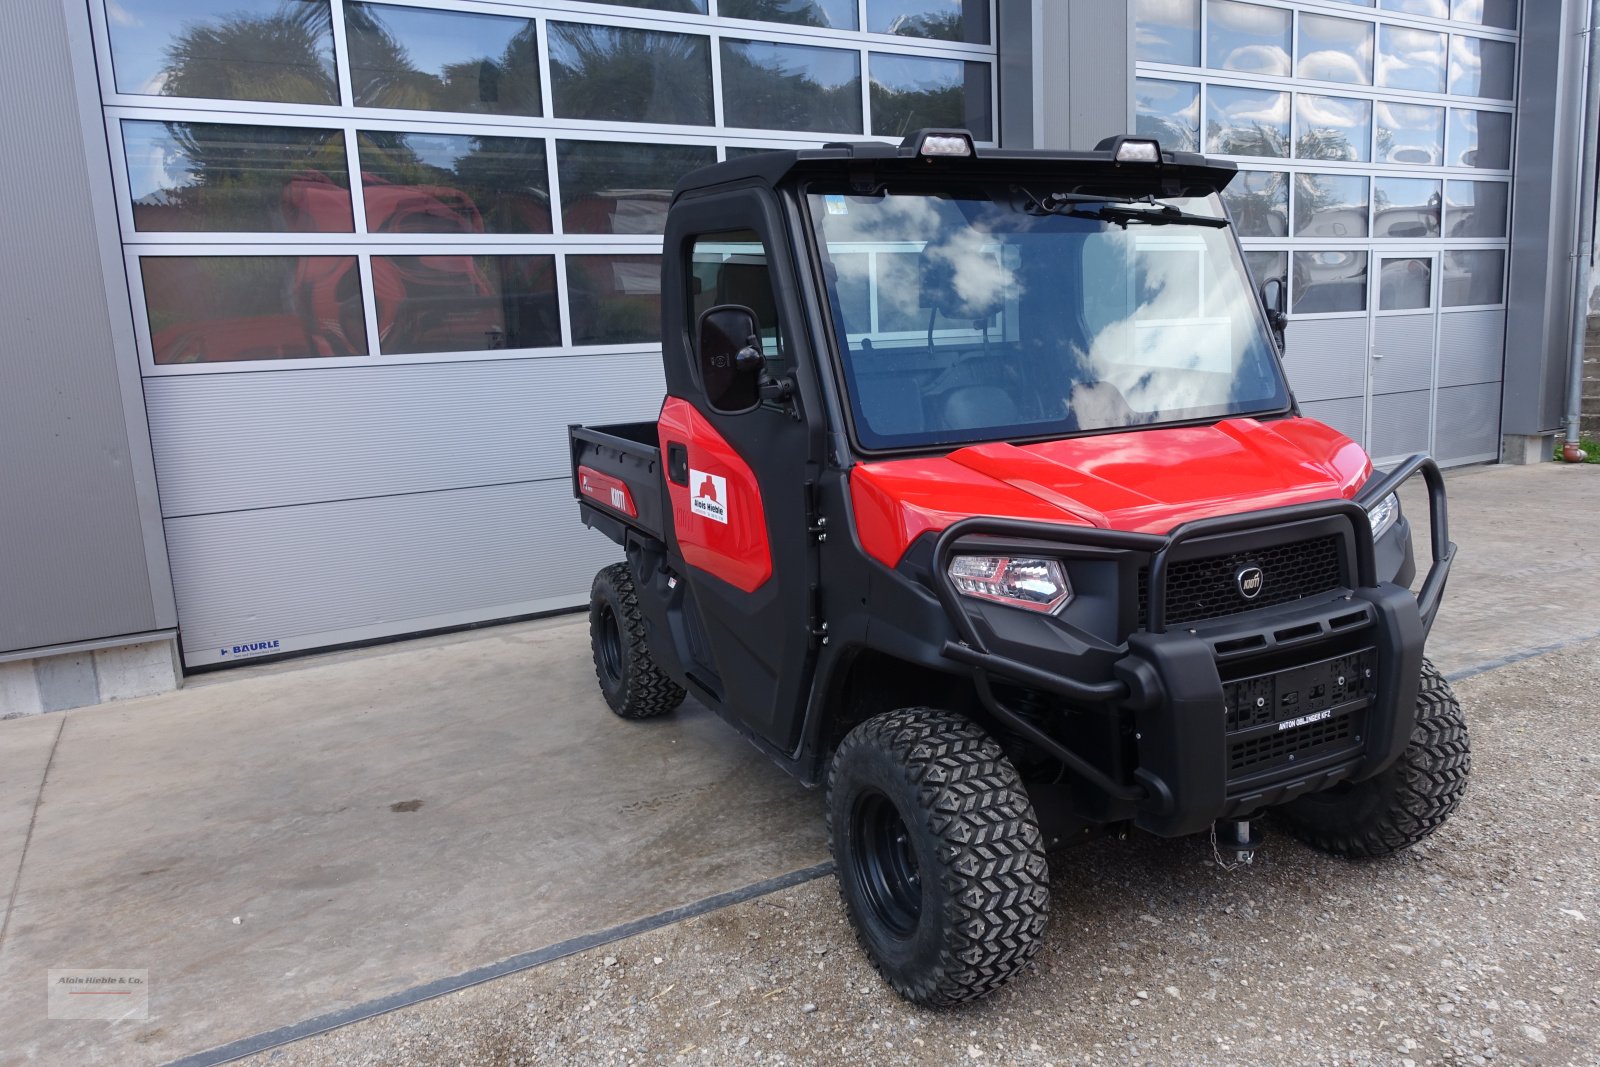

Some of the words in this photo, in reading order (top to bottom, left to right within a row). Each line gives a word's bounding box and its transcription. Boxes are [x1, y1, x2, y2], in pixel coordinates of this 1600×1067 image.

[694, 499, 706, 510] Alois
[706, 503, 724, 516] Hieble
[1278, 719, 1296, 731] ANTON
[1321, 709, 1331, 719] KFZ
